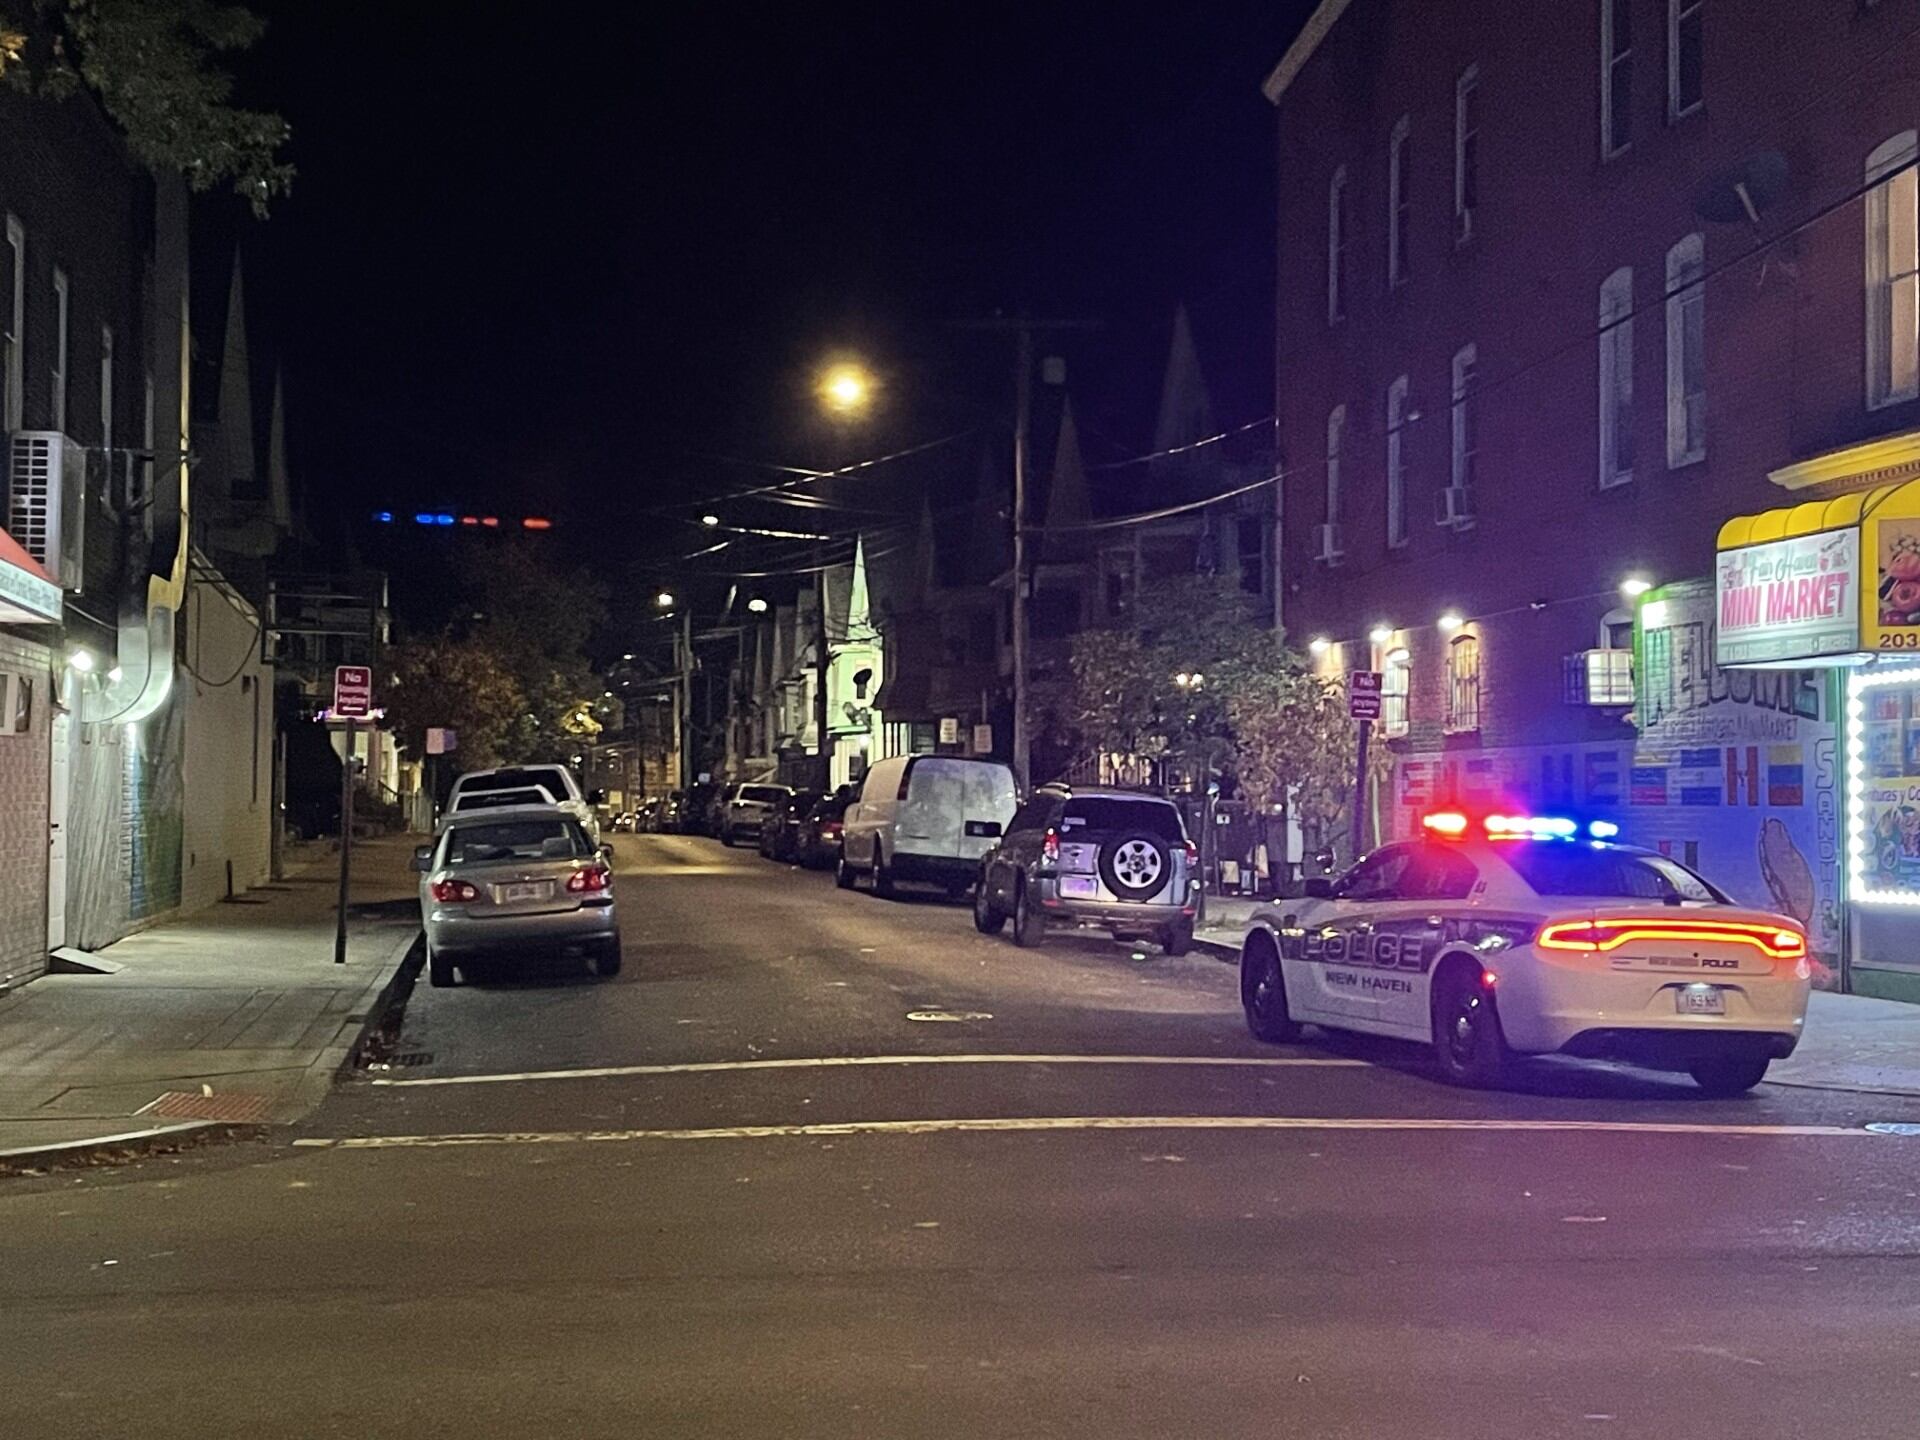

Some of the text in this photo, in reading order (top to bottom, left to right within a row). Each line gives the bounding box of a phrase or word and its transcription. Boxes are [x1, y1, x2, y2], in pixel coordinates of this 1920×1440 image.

[1721, 572, 1850, 630] MINI MARKET
[345, 672, 362, 683] No
[1359, 677, 1375, 687] No
[1299, 930, 1426, 971] POLICE
[1701, 958, 1739, 969] POLICE
[1325, 970, 1412, 993] NEW HAVEN
